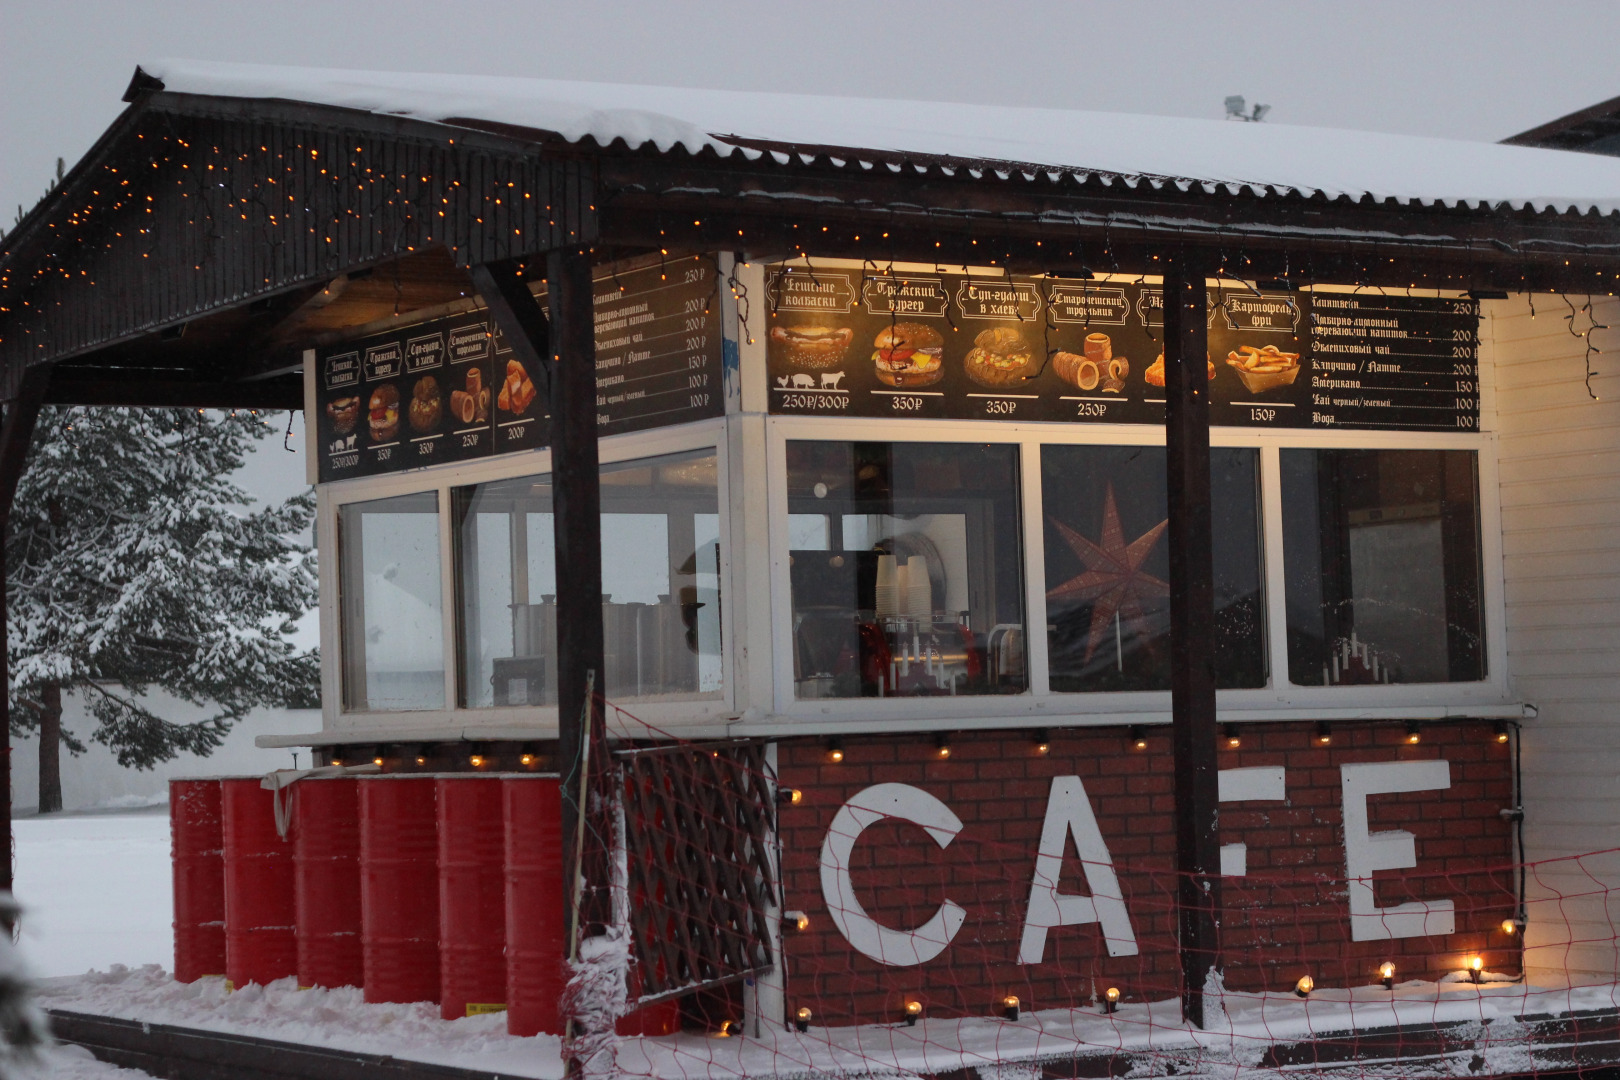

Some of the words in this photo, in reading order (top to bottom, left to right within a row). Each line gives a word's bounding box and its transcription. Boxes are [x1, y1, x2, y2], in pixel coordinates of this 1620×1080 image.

[785, 296, 837, 308] колбаски
[980, 304, 986, 313] в
[1453, 303, 1471, 314] 250
[1252, 315, 1272, 327] фри
[1370, 328, 1408, 339] напиток
[1453, 330, 1471, 341] 200
[1375, 344, 1390, 355] чай
[1453, 346, 1471, 358] 200
[1312, 359, 1356, 372] Капучино
[1453, 363, 1471, 375] 200
[1312, 376, 1360, 389] Американо
[1456, 381, 1472, 392] 150
[1456, 398, 1472, 409] 100
[1312, 411, 1335, 426] Вода
[1456, 416, 1473, 427] 100
